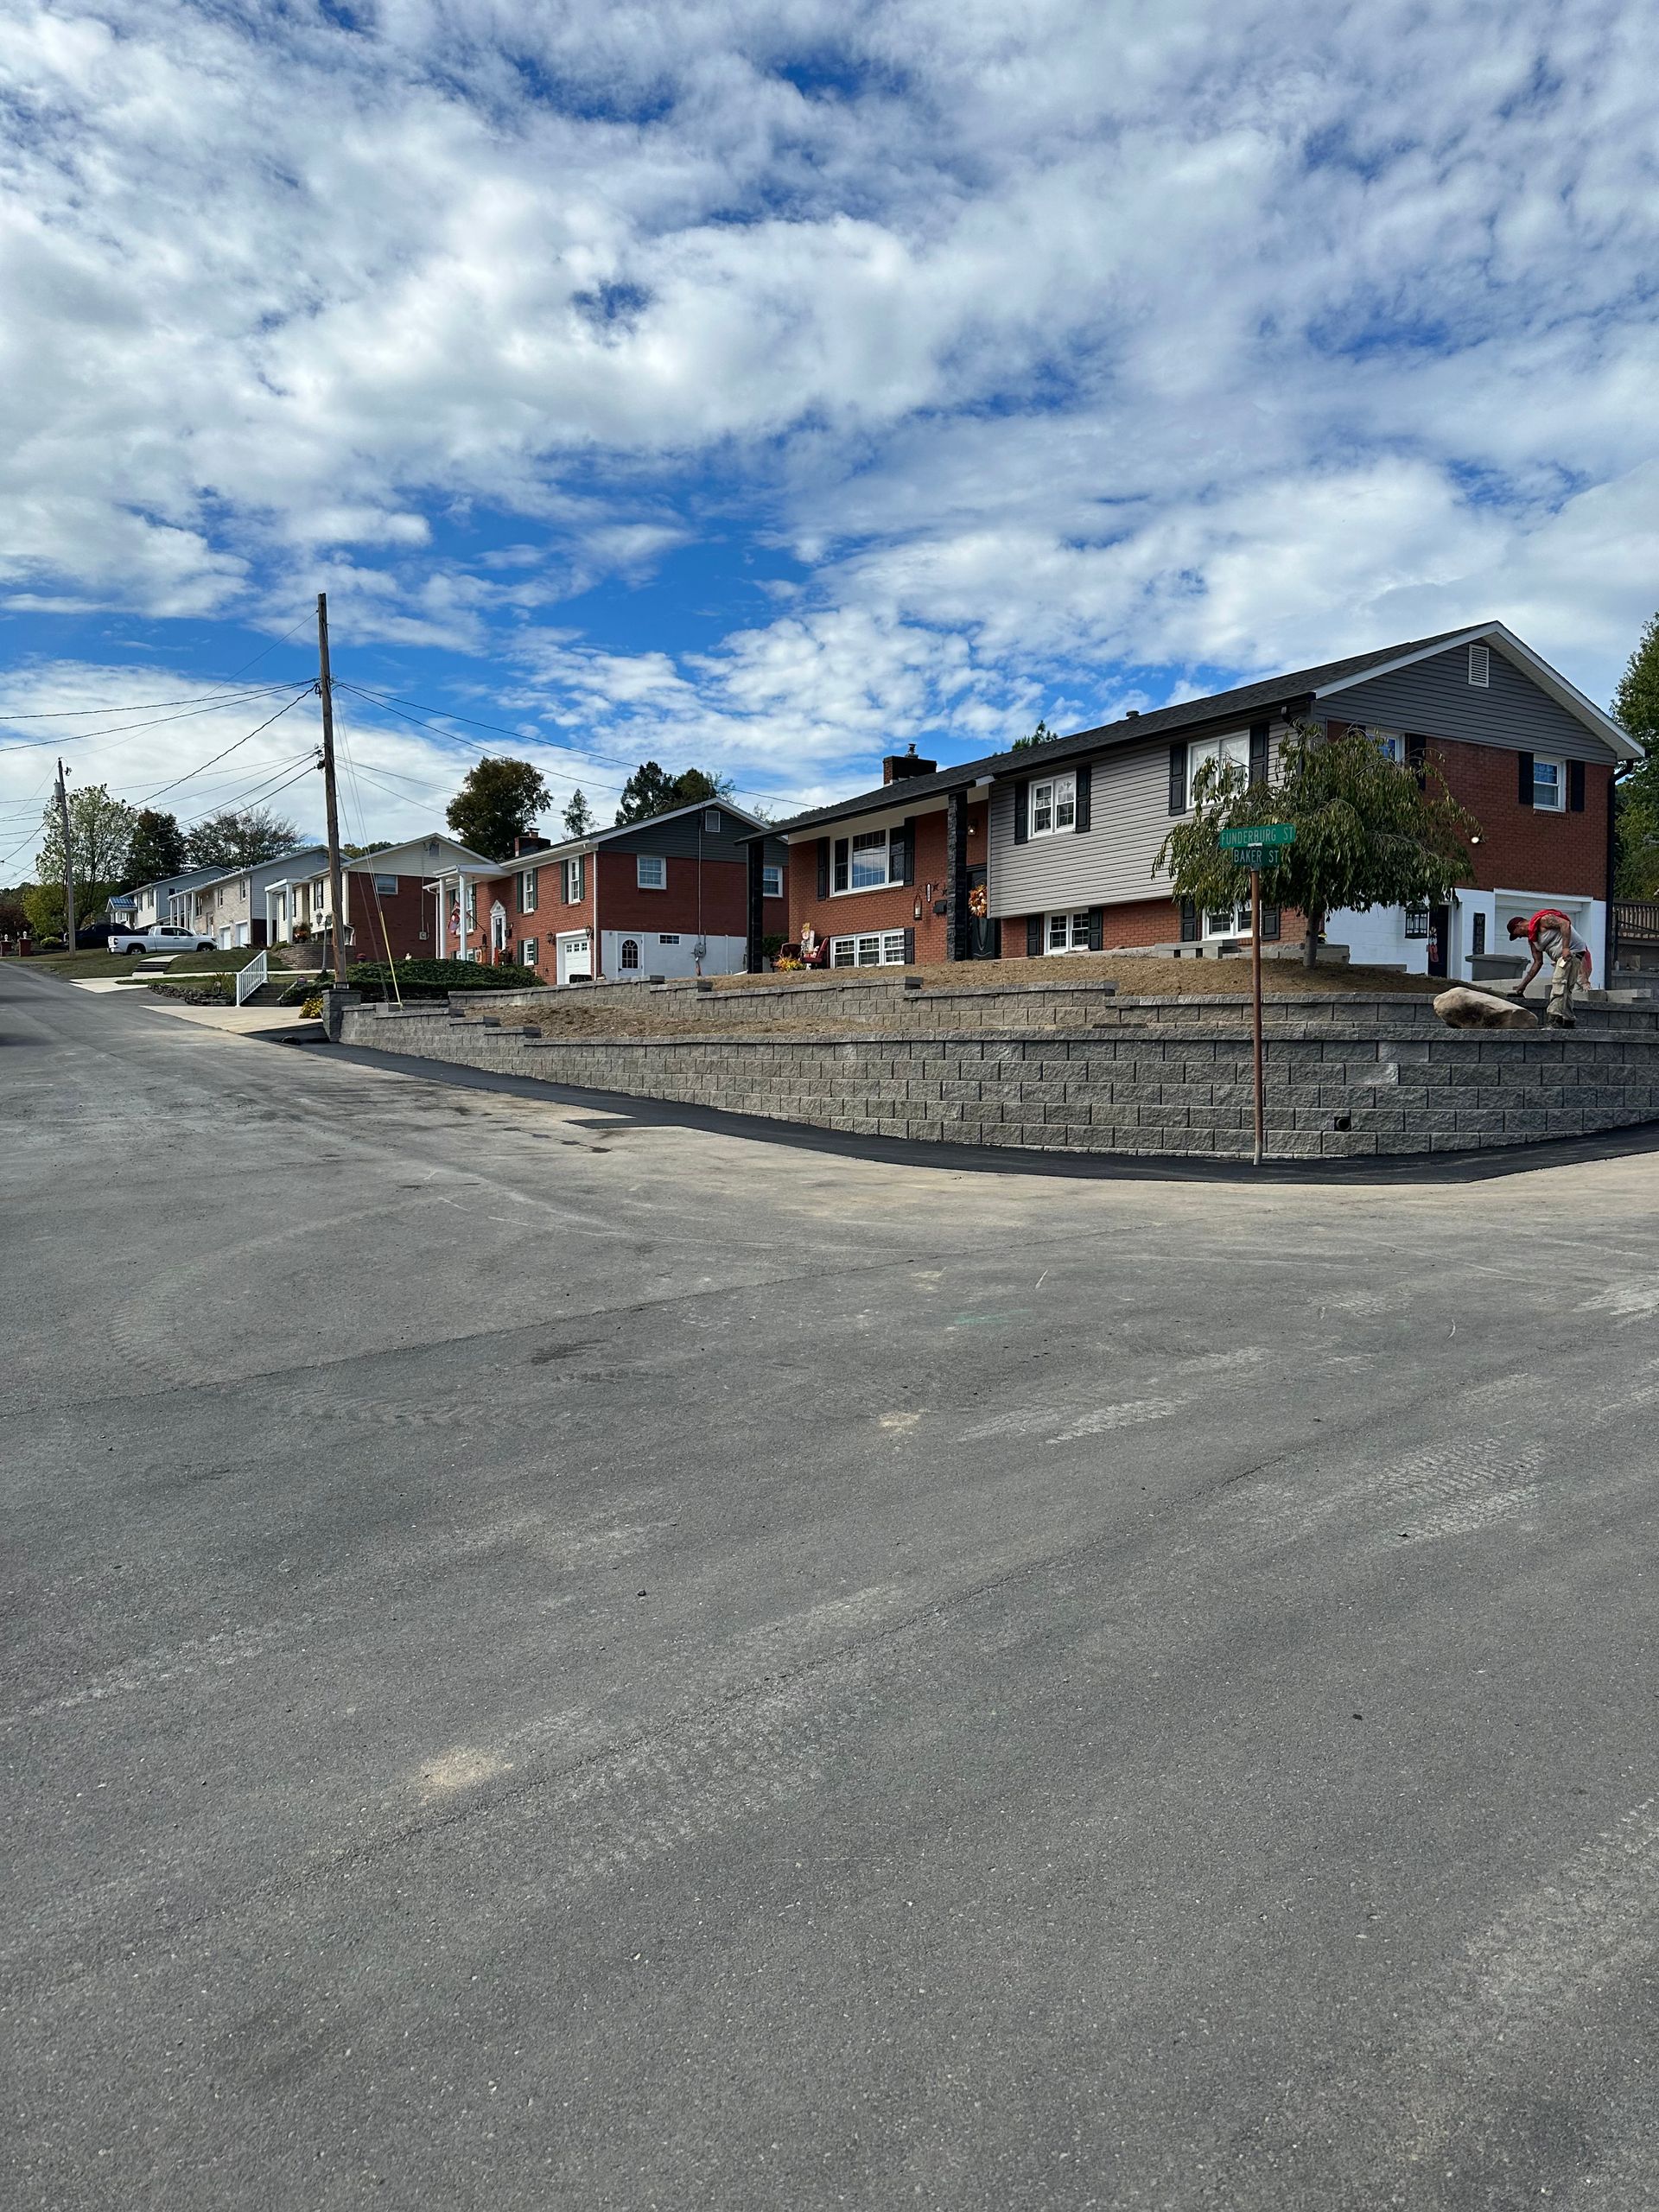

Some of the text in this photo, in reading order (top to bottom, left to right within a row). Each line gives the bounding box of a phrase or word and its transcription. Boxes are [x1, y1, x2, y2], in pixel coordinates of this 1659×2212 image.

[1221, 826, 1294, 845] FUNDERBURG ST
[1234, 849, 1279, 863] BAKER ST
